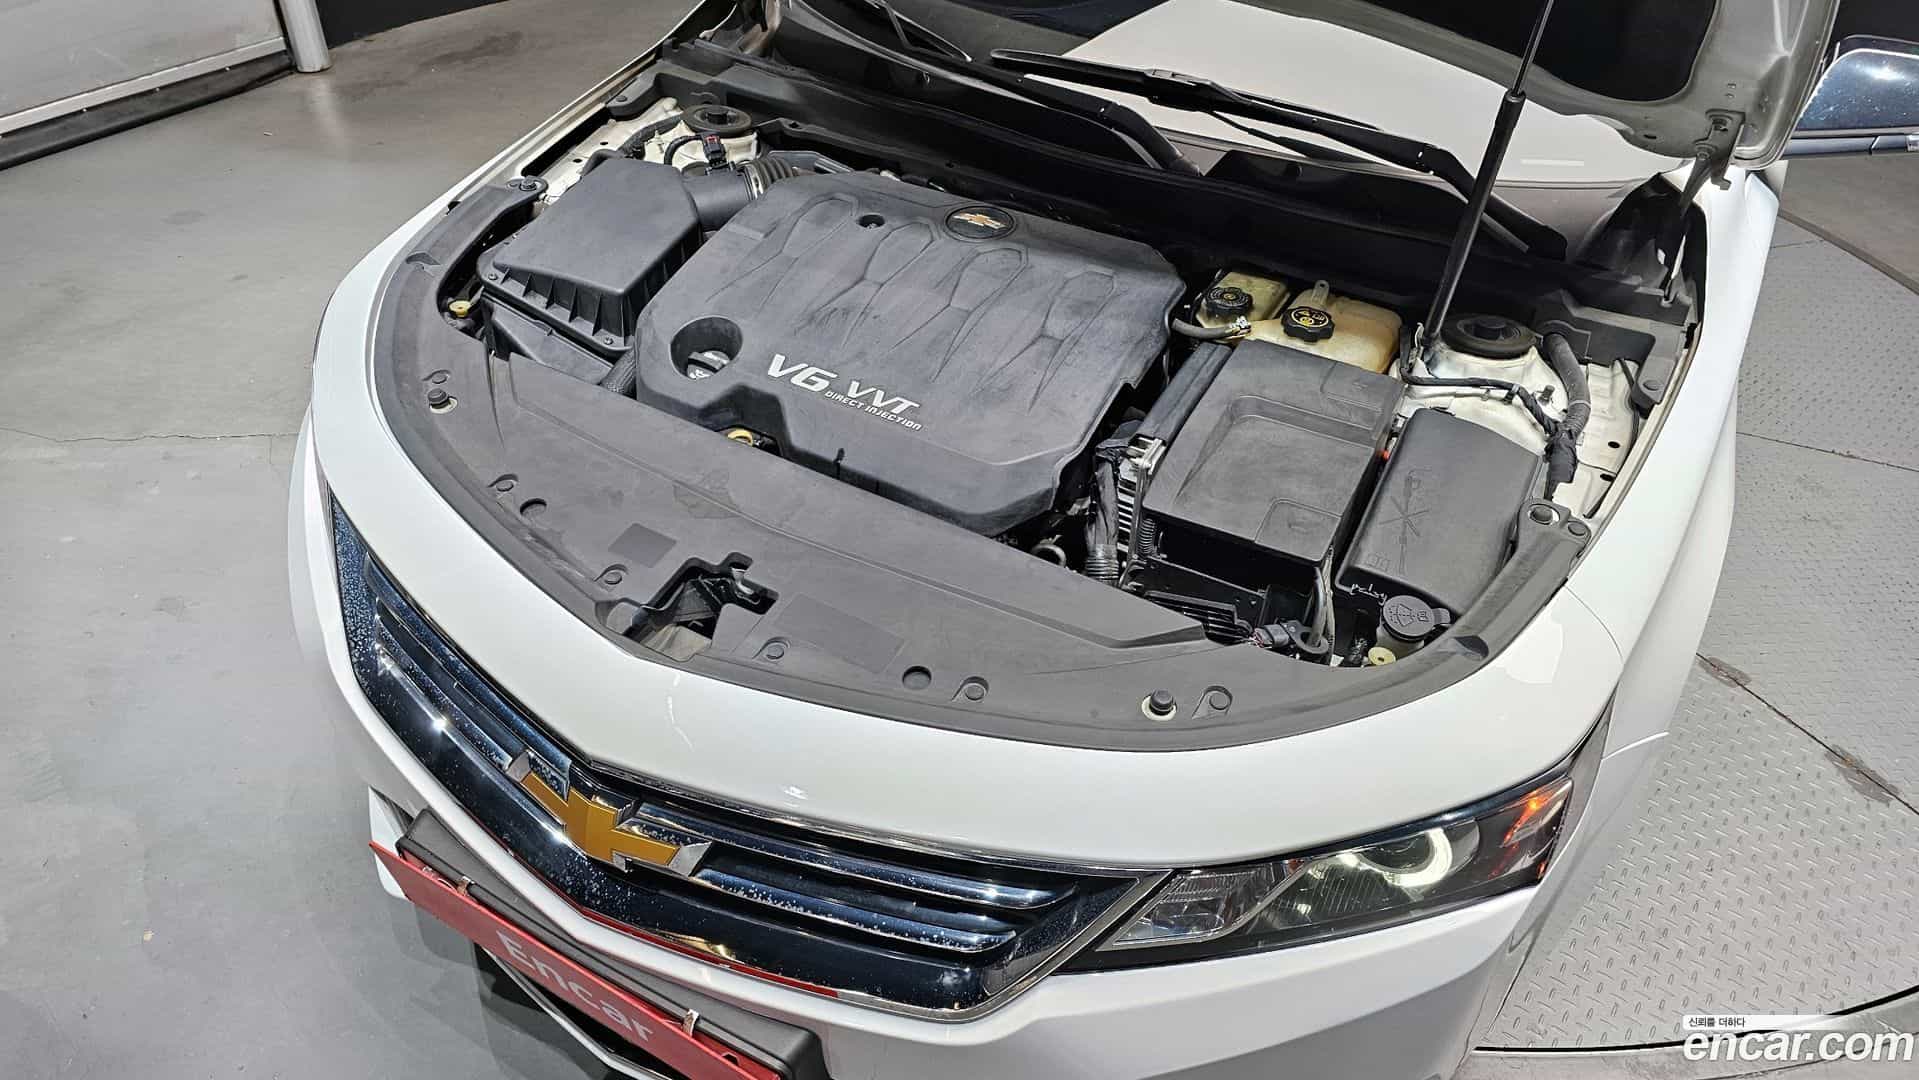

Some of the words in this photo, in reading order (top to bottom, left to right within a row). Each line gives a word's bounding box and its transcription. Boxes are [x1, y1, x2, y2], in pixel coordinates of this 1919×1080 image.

[767, 353, 838, 392] V6
[847, 381, 920, 414] VVT
[824, 390, 867, 409] DIRECT
[865, 405, 923, 431] INJECTION
[497, 930, 653, 1041] Encar
